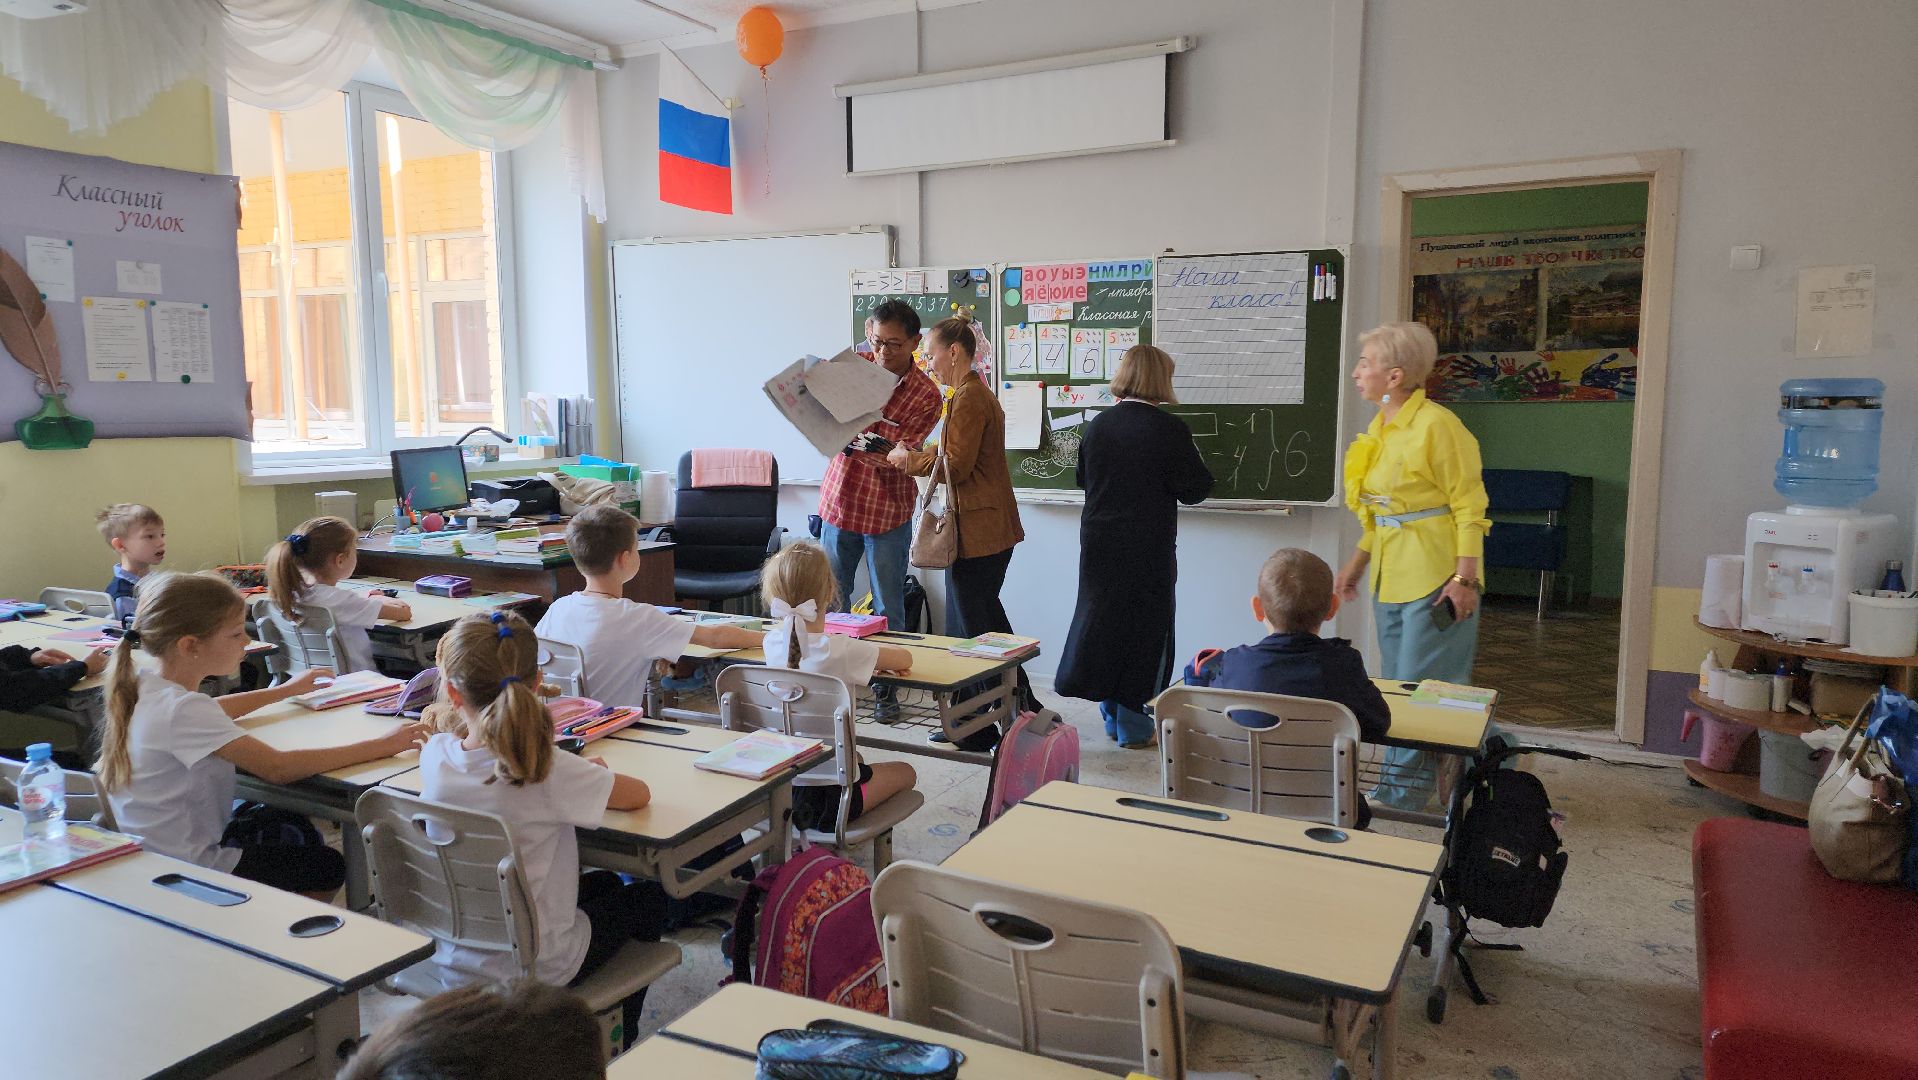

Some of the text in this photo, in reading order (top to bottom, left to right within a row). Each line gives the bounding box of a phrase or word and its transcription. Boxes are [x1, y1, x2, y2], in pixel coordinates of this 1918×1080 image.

[51, 174, 165, 210] Классный
[115, 210, 184, 233] уголок
[1489, 237, 1519, 248] лицей
[1456, 254, 1515, 269] НАШЕ
[1173, 266, 1240, 288] Наш
[1078, 305, 1140, 321] Классная
[1008, 328, 1016, 340] 2
[1041, 328, 1049, 339] 4
[1075, 332, 1083, 344] 6
[1108, 332, 1116, 344] 5
[1018, 343, 1032, 369] 2
[1045, 343, 1065, 368] 4
[1082, 348, 1100, 374] 6
[1284, 430, 1311, 477] 6
